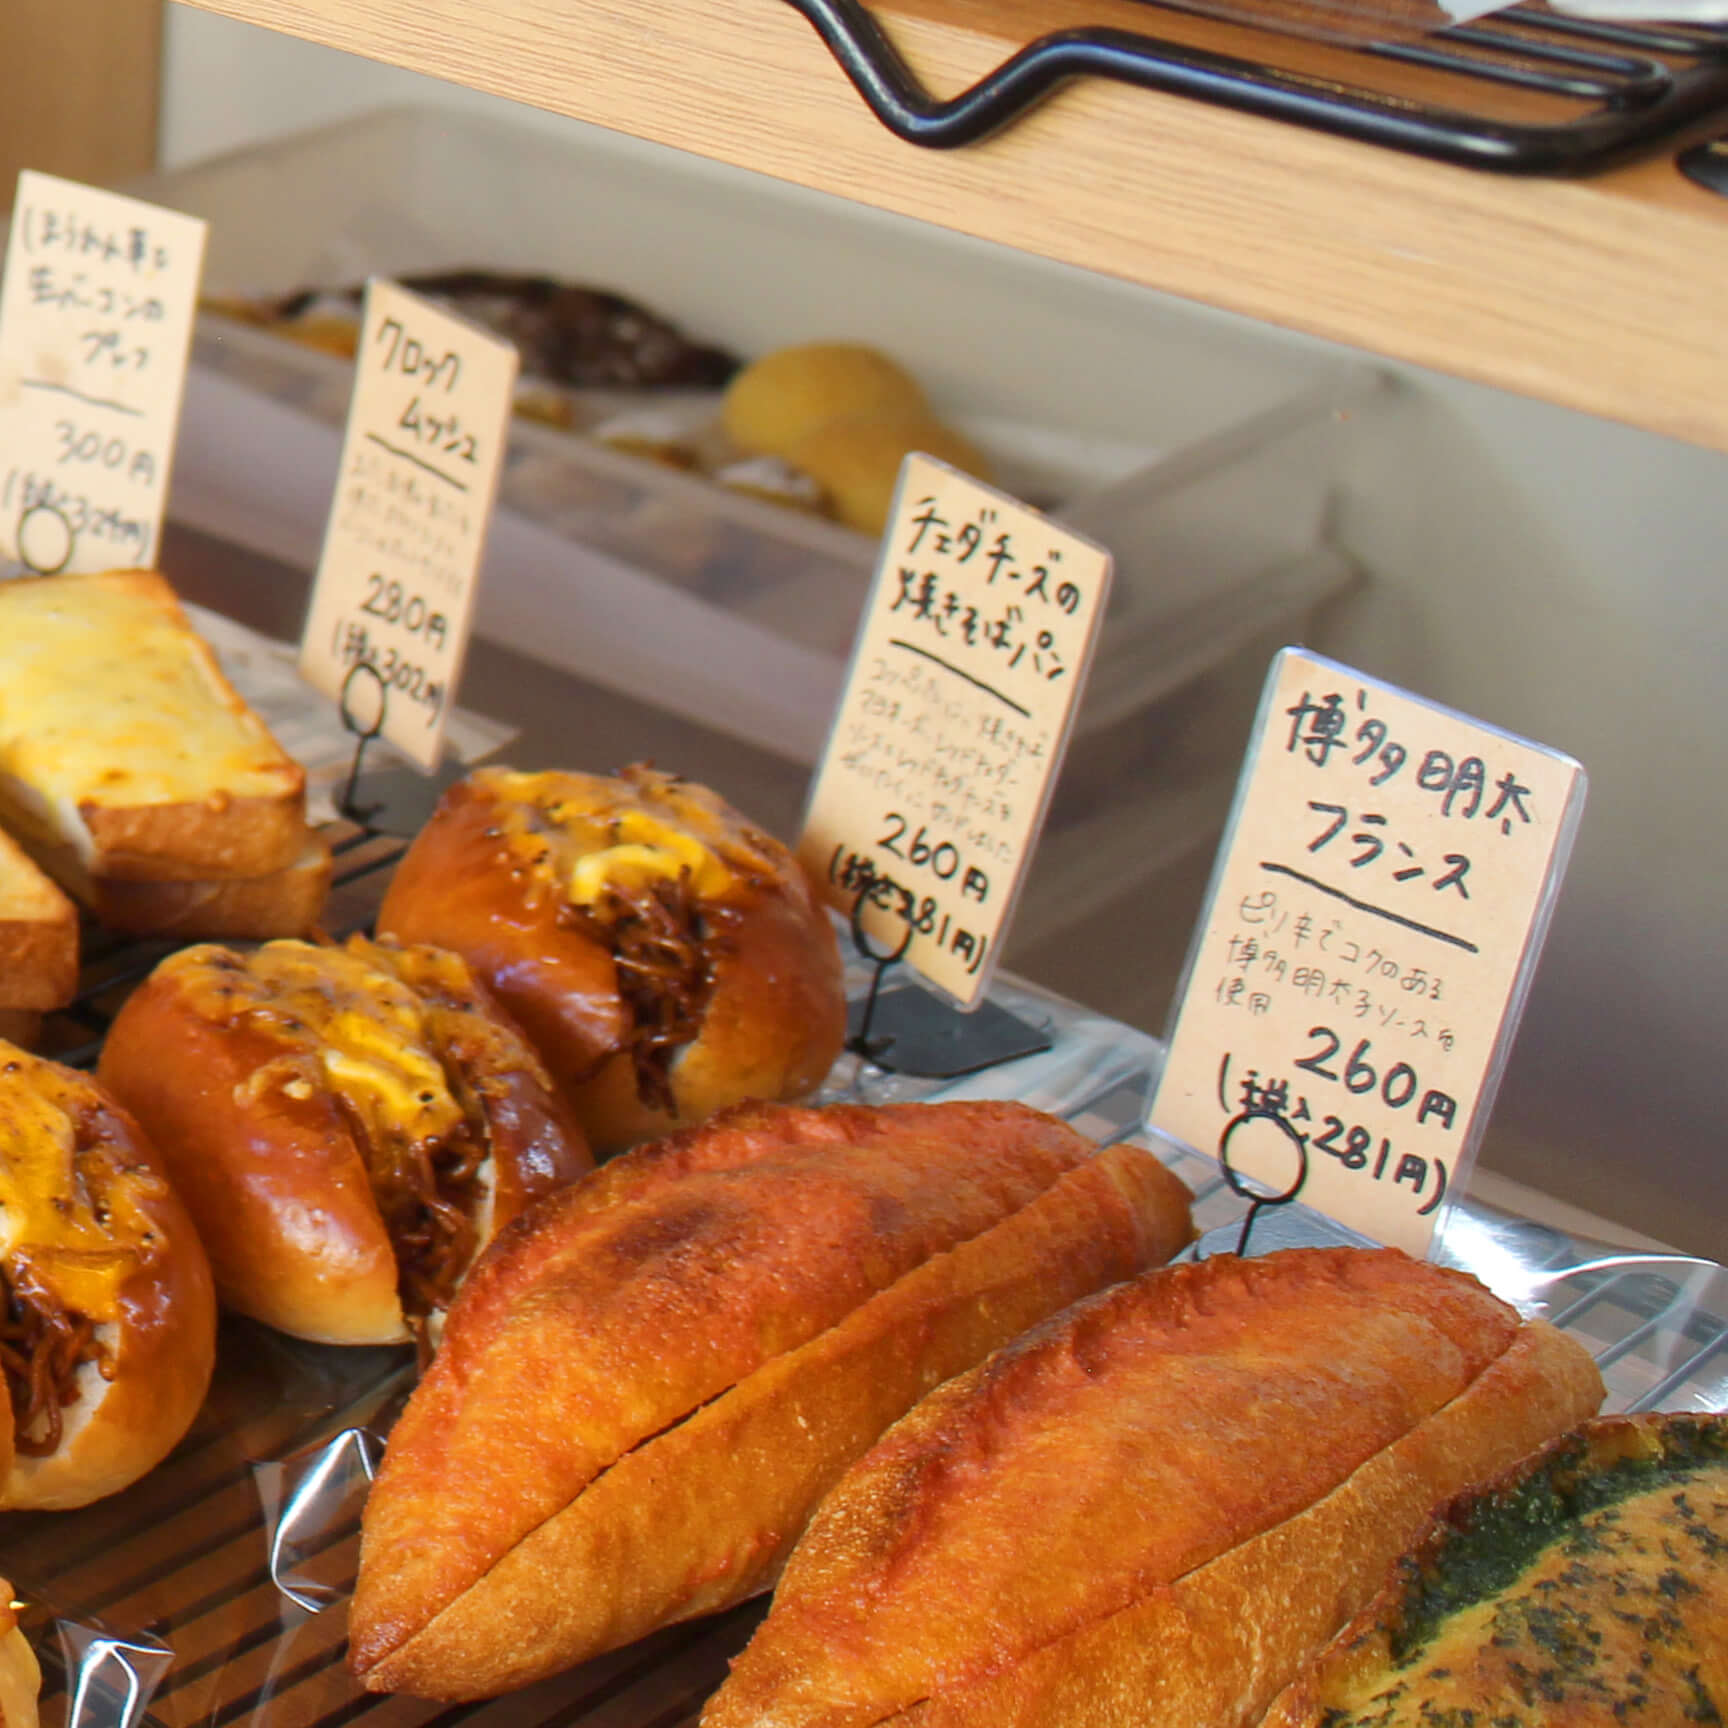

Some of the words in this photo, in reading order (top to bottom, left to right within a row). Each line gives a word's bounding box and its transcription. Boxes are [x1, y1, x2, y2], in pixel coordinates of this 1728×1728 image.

[375, 315, 462, 394] クロック
[54, 420, 156, 487] 300円
[397, 395, 478, 465] ムッシュ
[906, 495, 1081, 616] チェダチーズの
[359, 573, 448, 652] 280円
[889, 566, 1066, 681] 焼きそばパン
[1285, 688, 1533, 836] 博多明太
[875, 811, 991, 904] 260円
[1306, 800, 1473, 901] フランス
[1239, 889, 1446, 1003] ピリ辛でコクのある
[1215, 976, 1273, 1017] 使用
[1293, 1025, 1459, 1131] 260円
